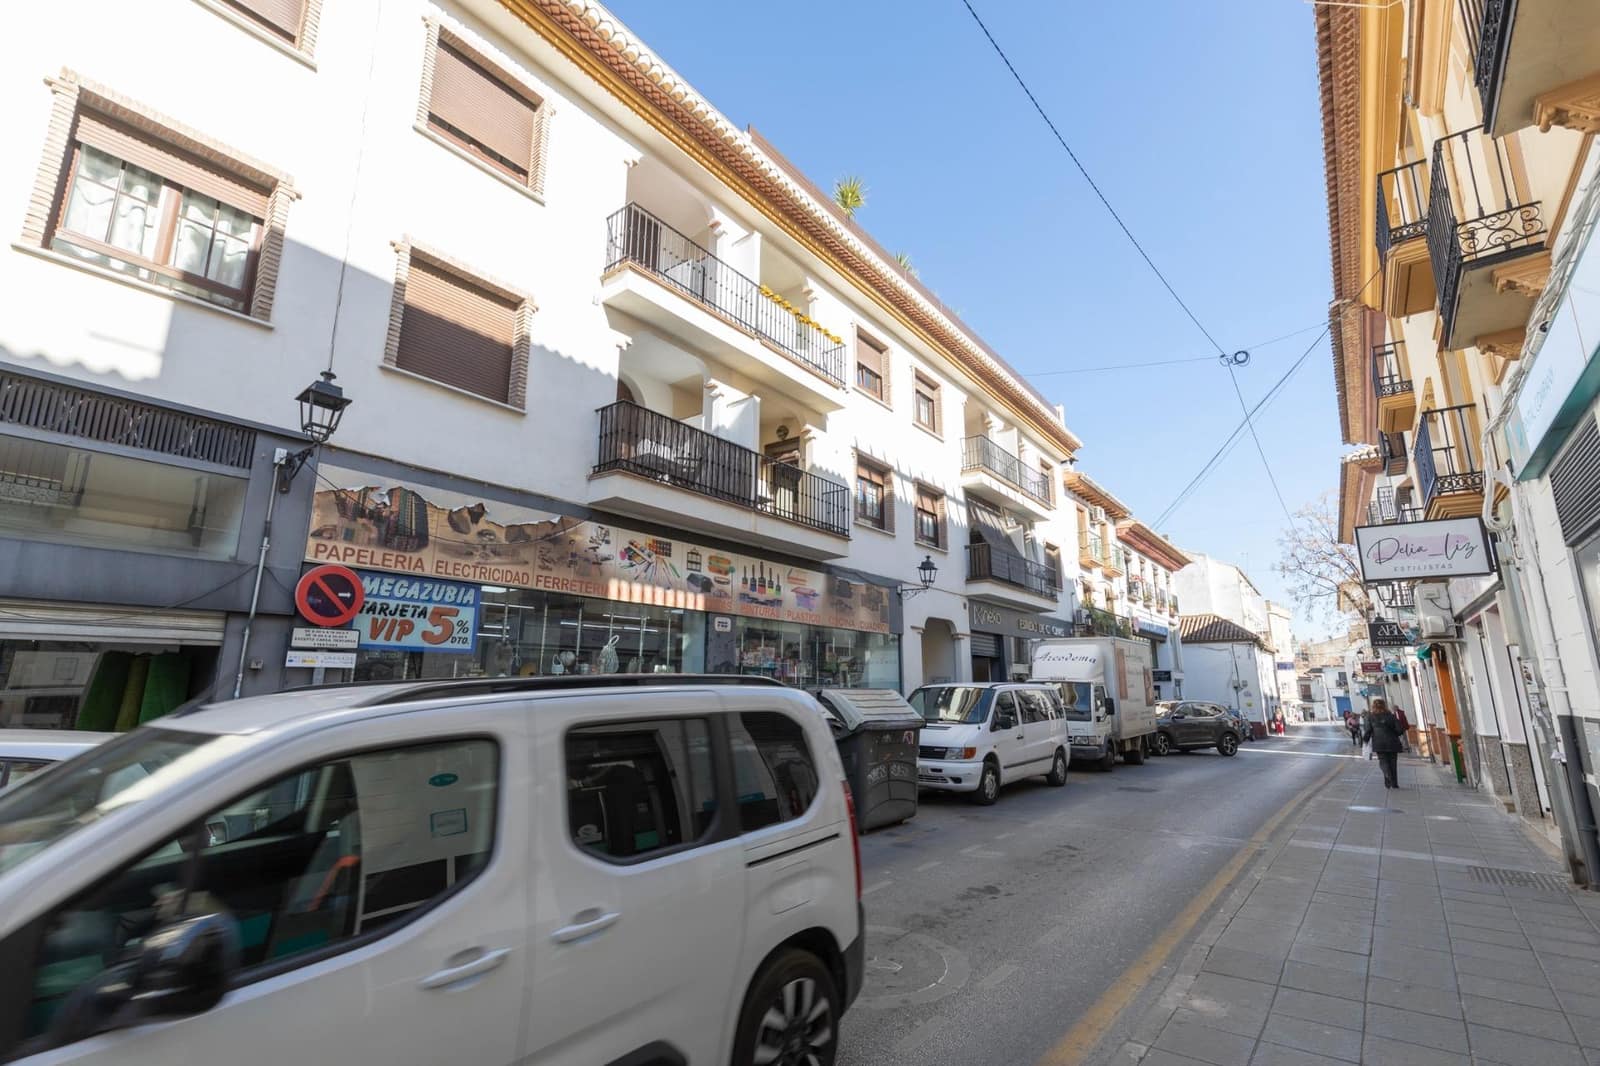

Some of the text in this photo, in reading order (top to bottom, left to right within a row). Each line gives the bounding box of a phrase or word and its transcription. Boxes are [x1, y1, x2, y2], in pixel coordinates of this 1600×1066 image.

[314, 543, 425, 573] PAPELERIA
[435, 560, 530, 585] ELECTRICIDAD
[1394, 563, 1453, 572] ESTILISTAS
[362, 576, 476, 605] MEGAZUBIA
[359, 601, 428, 619] TARJETA
[369, 616, 415, 642] VIP
